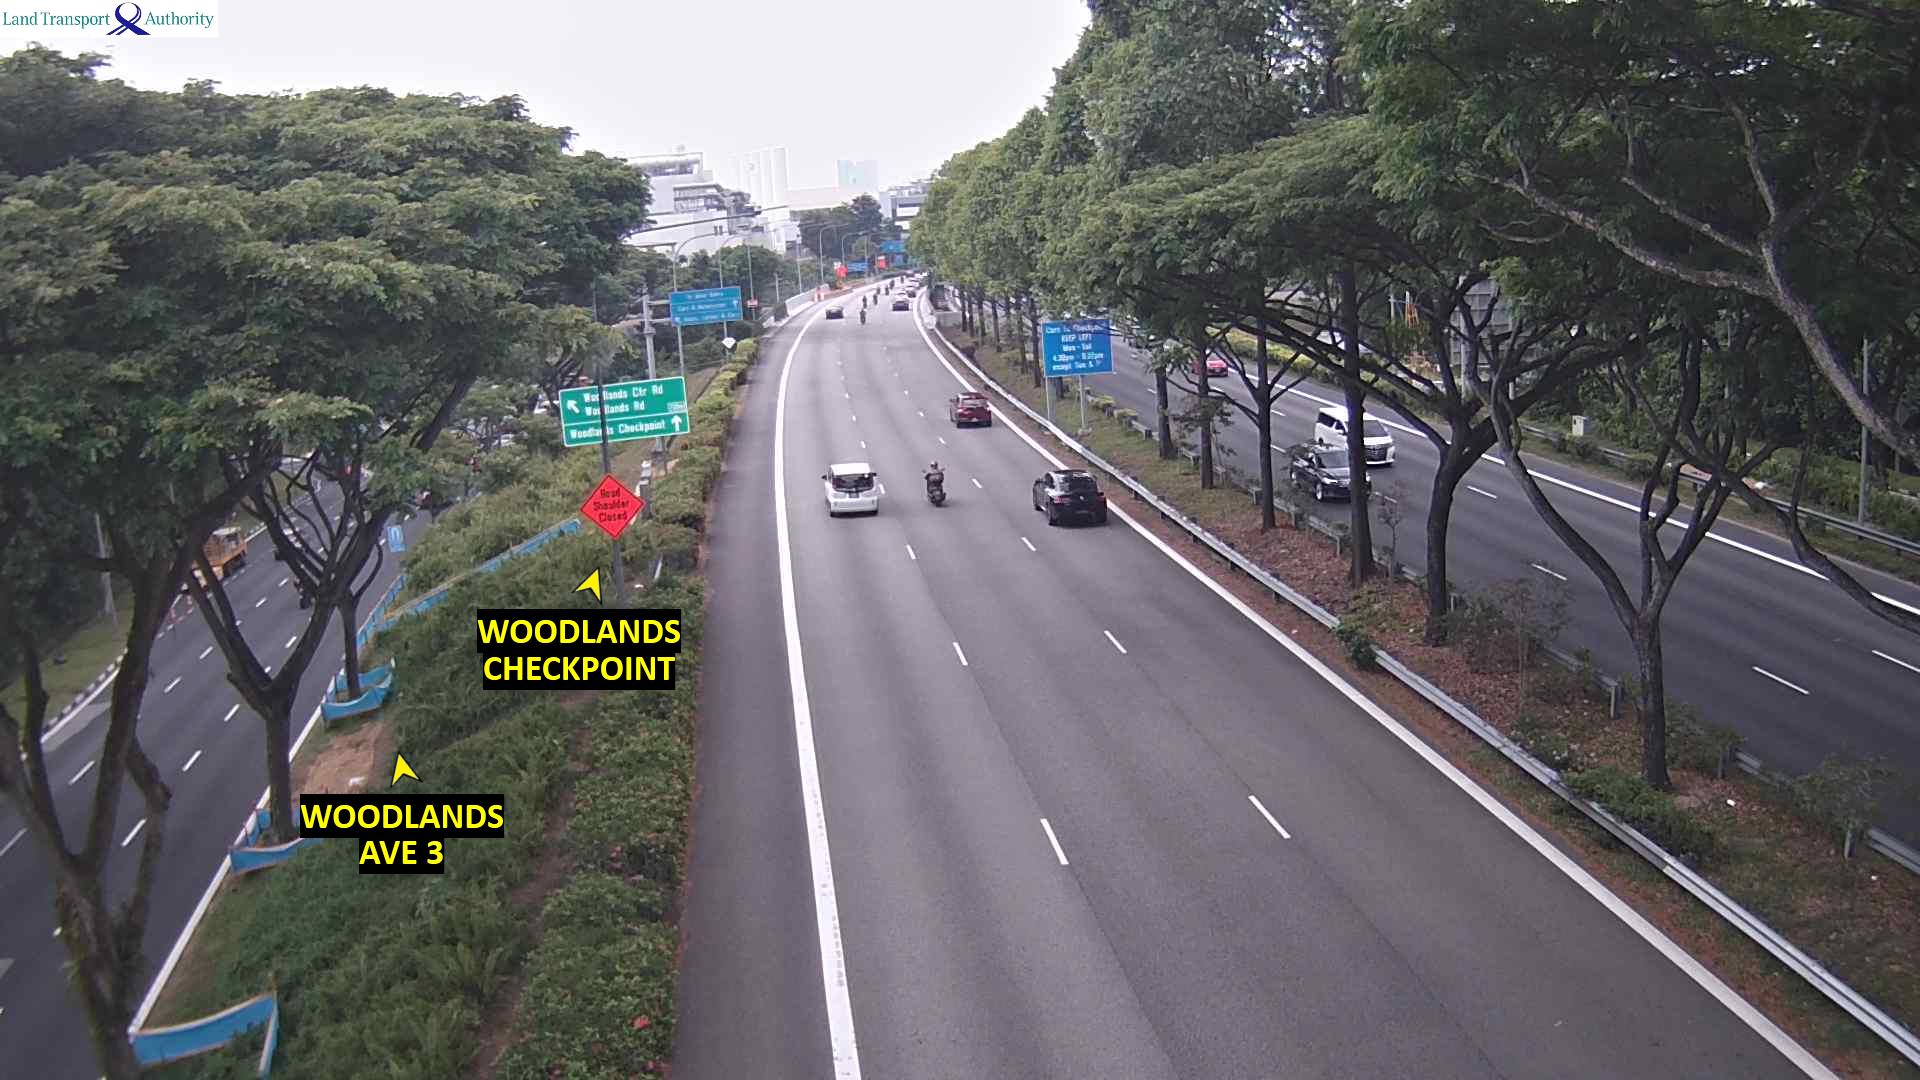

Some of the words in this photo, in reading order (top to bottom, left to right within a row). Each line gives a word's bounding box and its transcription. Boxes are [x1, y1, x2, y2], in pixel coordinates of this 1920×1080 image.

[584, 389, 628, 403] Woolands
[632, 386, 647, 398] Ctr
[651, 383, 663, 395] Rd
[585, 402, 630, 416] Woolands
[633, 399, 645, 411] Rd
[619, 419, 665, 434] Checkpoint
